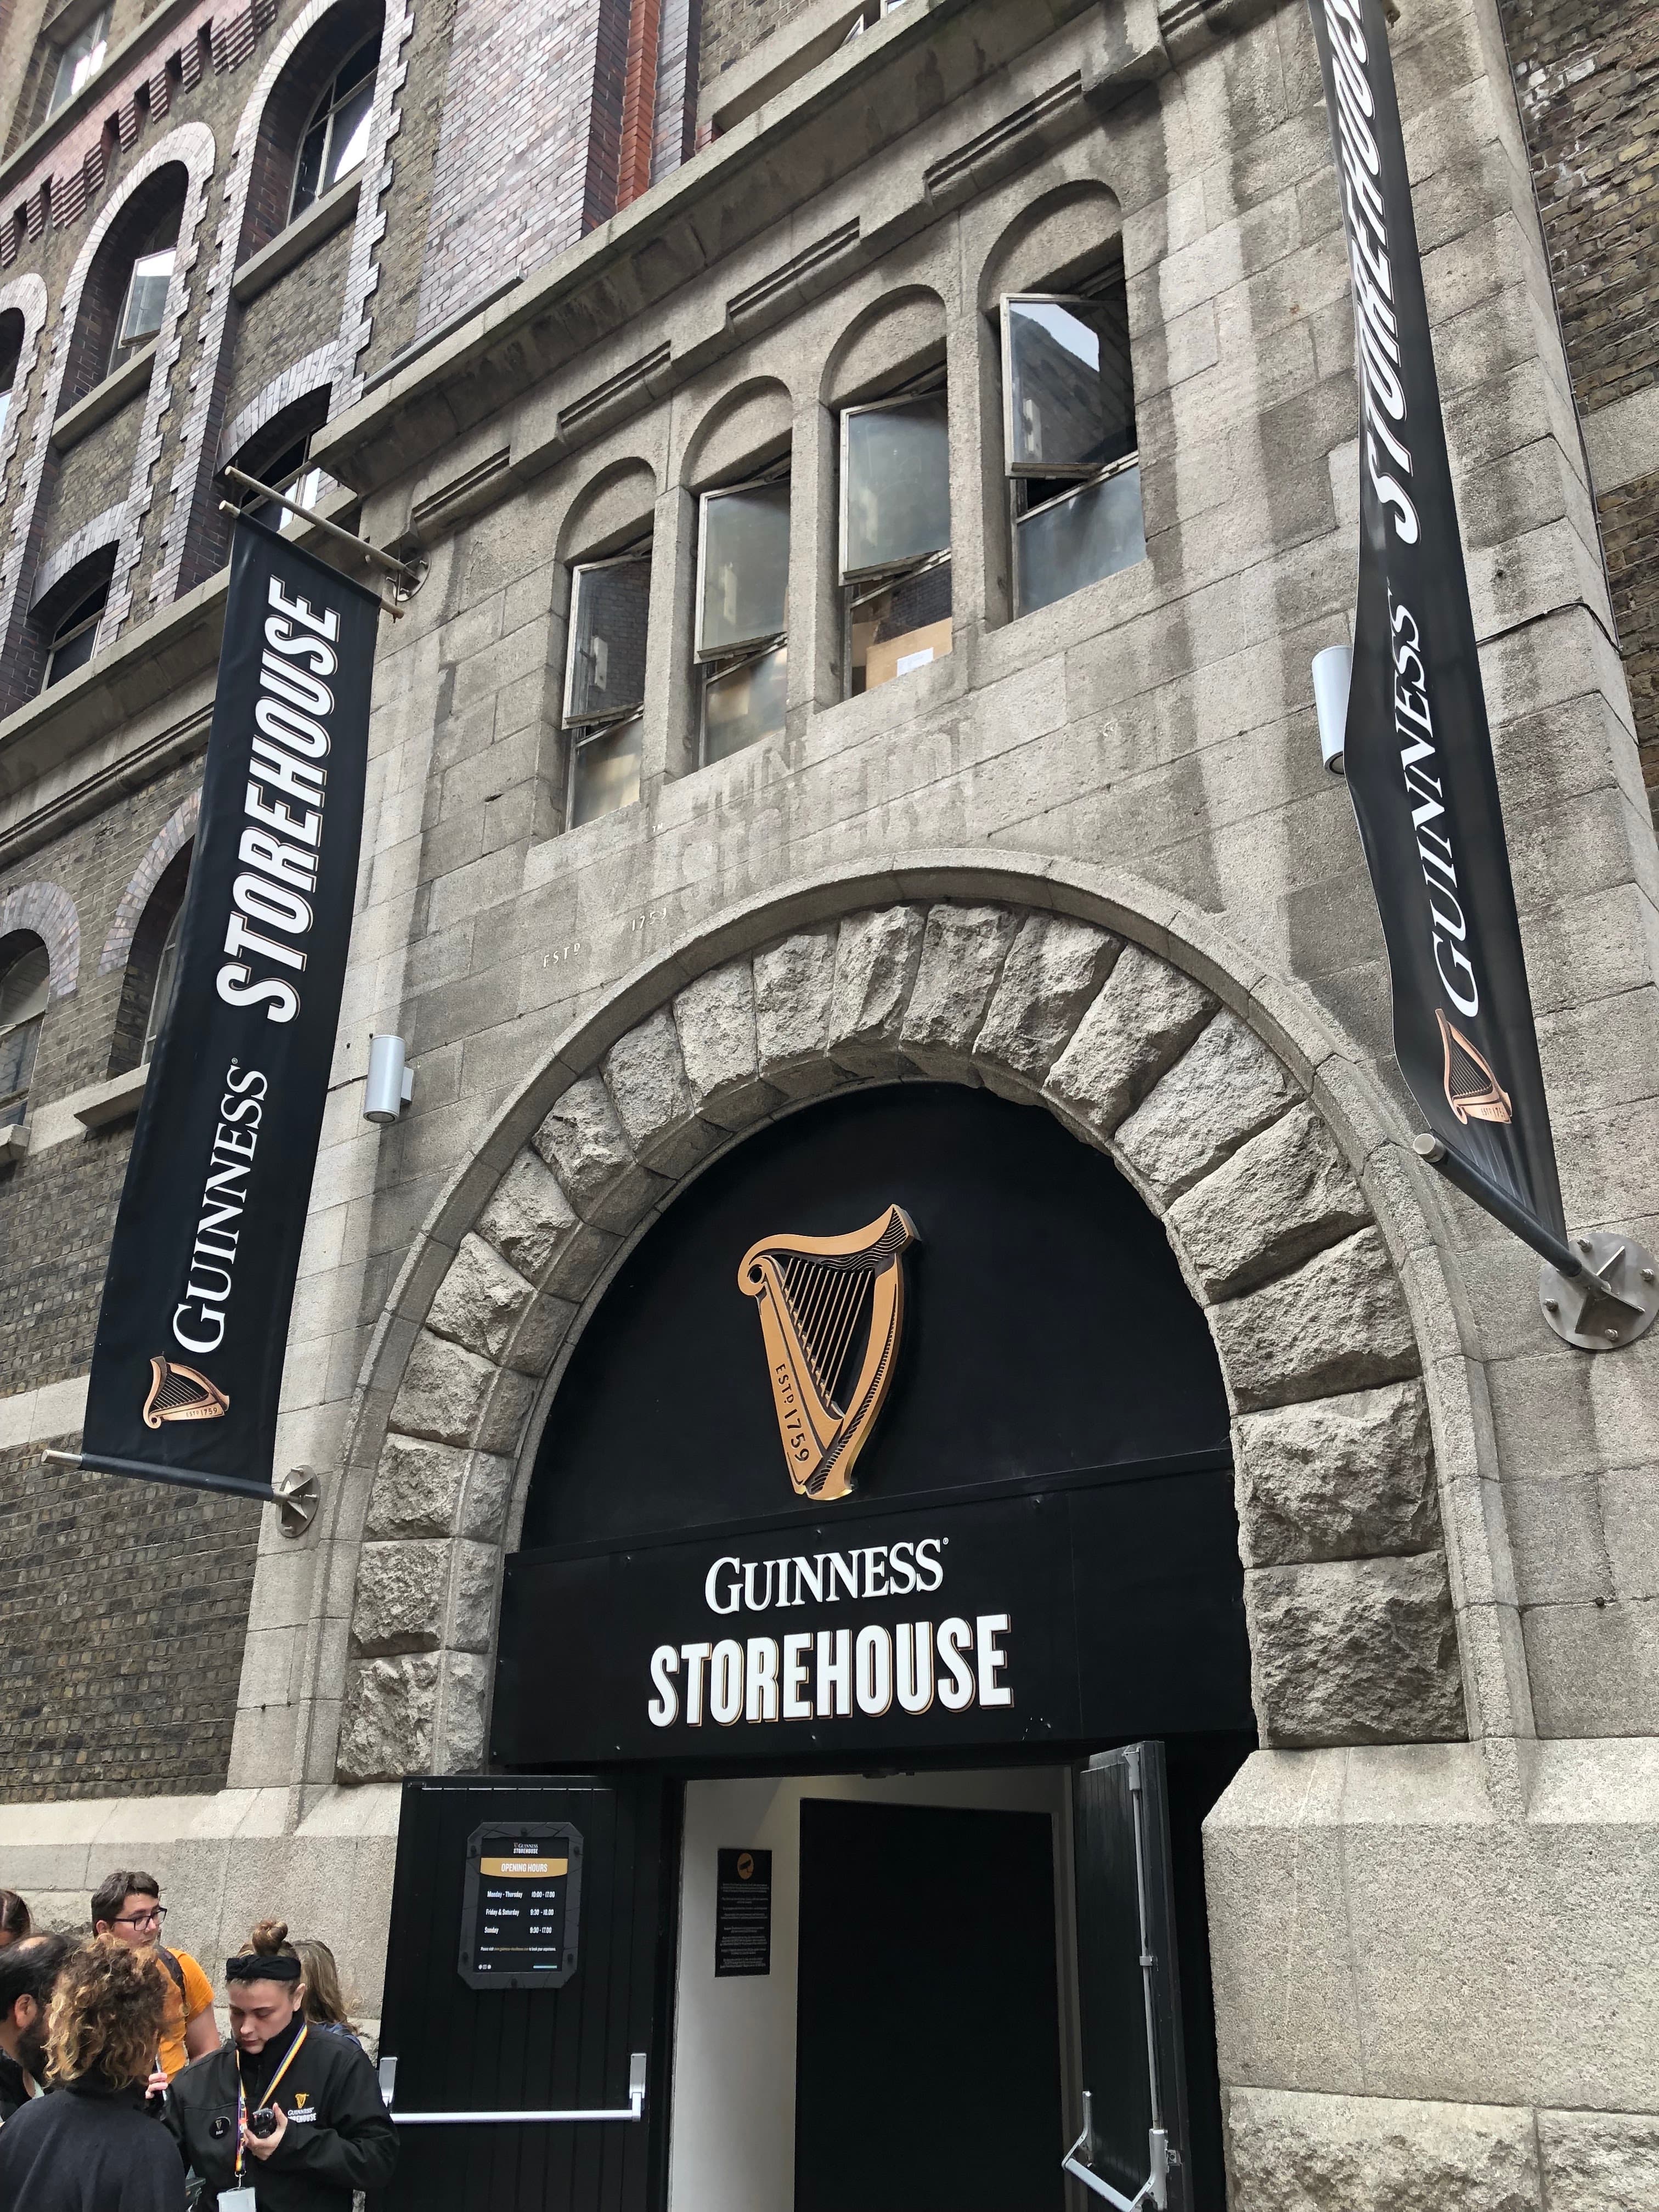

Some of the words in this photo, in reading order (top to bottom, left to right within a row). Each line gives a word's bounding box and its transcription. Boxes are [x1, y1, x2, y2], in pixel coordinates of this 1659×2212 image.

[1323, 0, 1422, 545] STOREHOUS
[216, 574, 341, 1024] STOREHOUSE
[173, 1065, 268, 1353] GUINNESS
[200, 1407, 218, 1416] 1759
[785, 1408, 810, 1462] 1759
[705, 1538, 944, 1615] GUINNESS
[648, 1613, 1015, 1728] STOREHOUSE
[501, 1863, 527, 1872] OPENING
[528, 1863, 548, 1873] HOURS
[487, 1891, 503, 1899] Monday
[505, 1891, 523, 1899] Thursday
[486, 1909, 498, 1917] Friday
[484, 1926, 499, 1934] Sunday
[287, 2108, 313, 2116] GUINNESS
